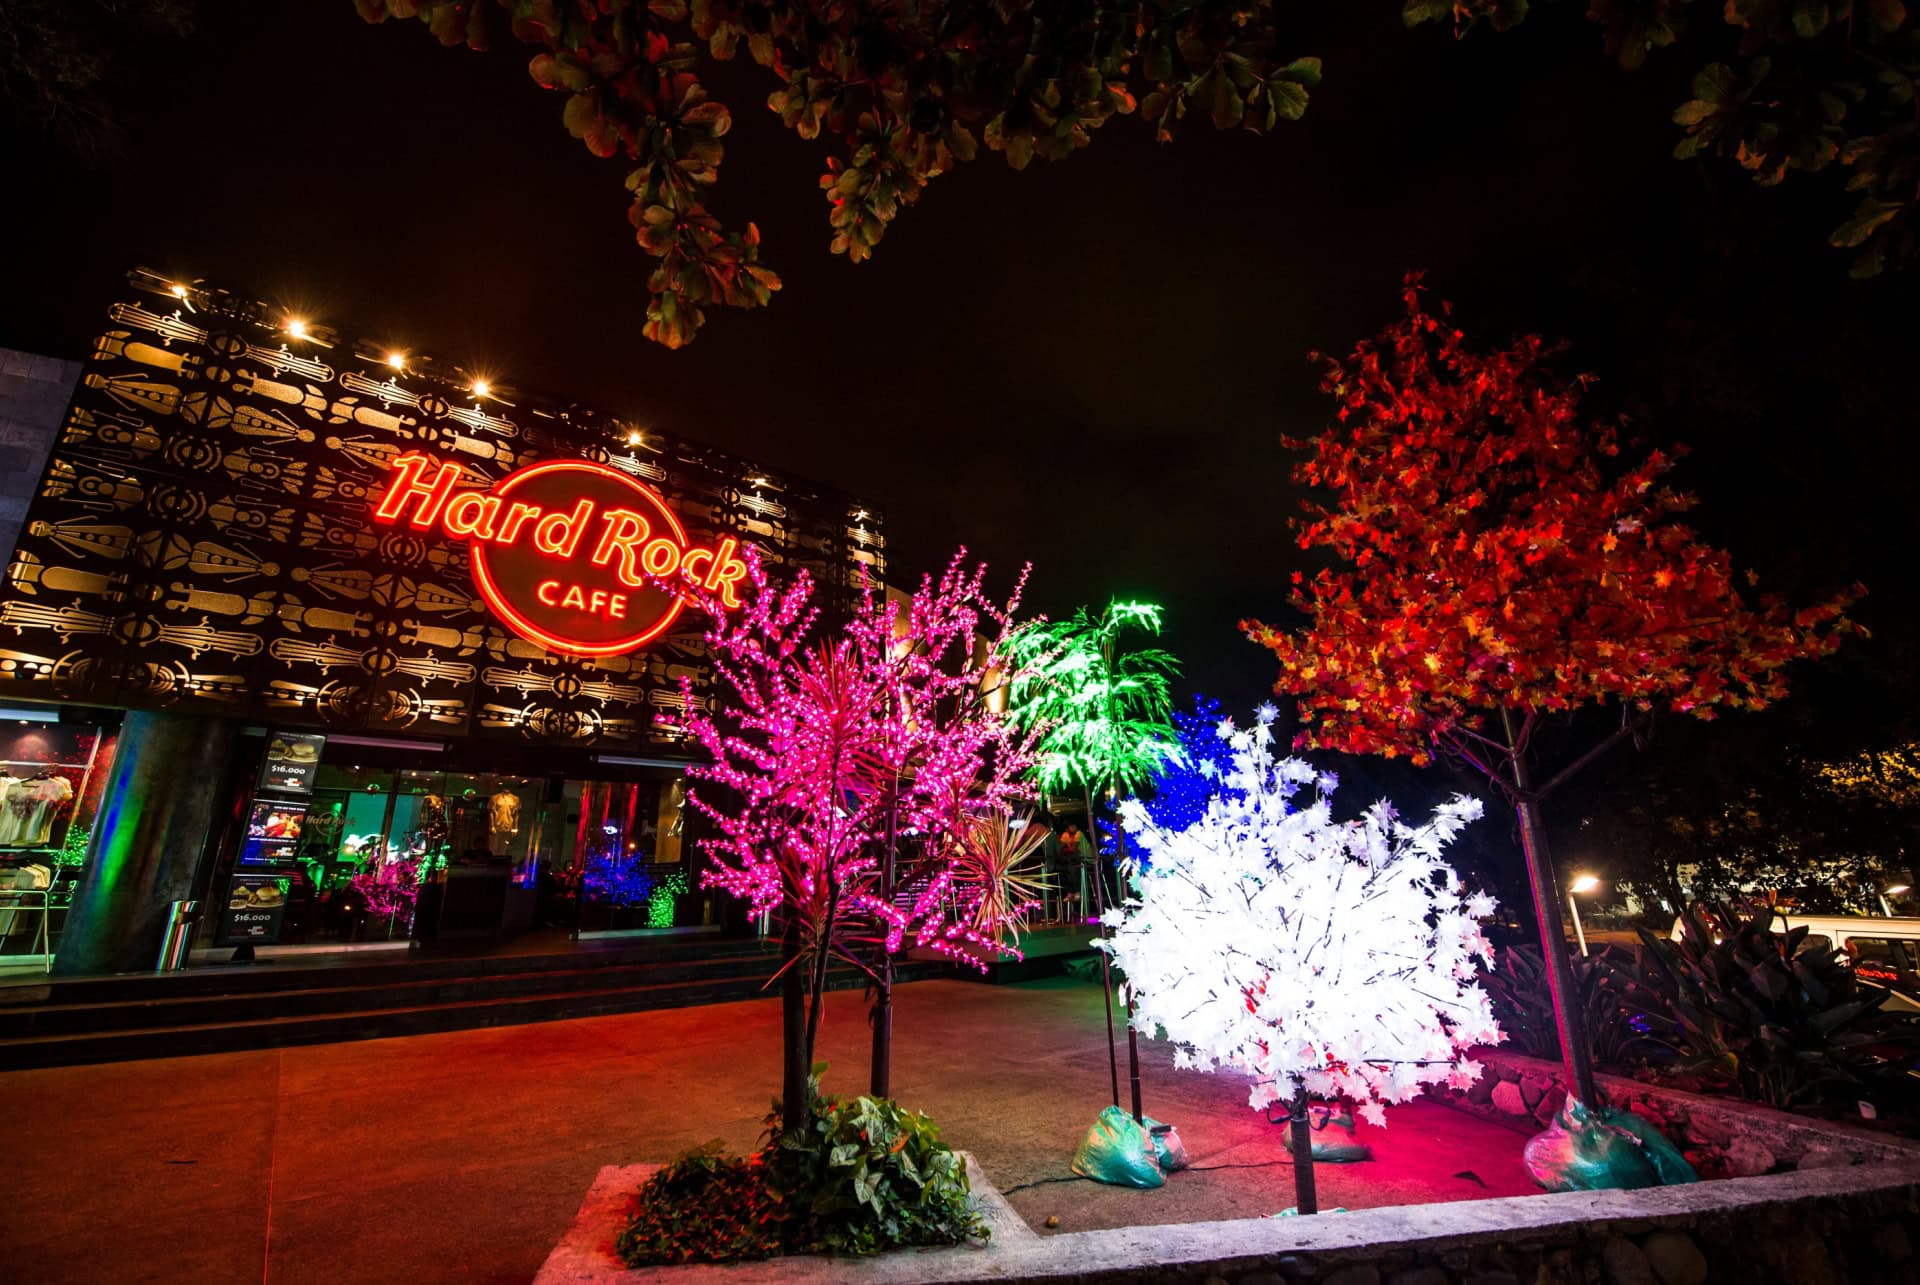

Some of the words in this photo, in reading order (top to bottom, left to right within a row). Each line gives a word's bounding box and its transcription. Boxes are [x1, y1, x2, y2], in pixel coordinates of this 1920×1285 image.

[377, 455, 595, 559] Hard
[592, 508, 748, 609] Rock
[537, 580, 629, 619] CAFE
[271, 764, 306, 775] $16.000
[233, 913, 271, 922] $16.000
